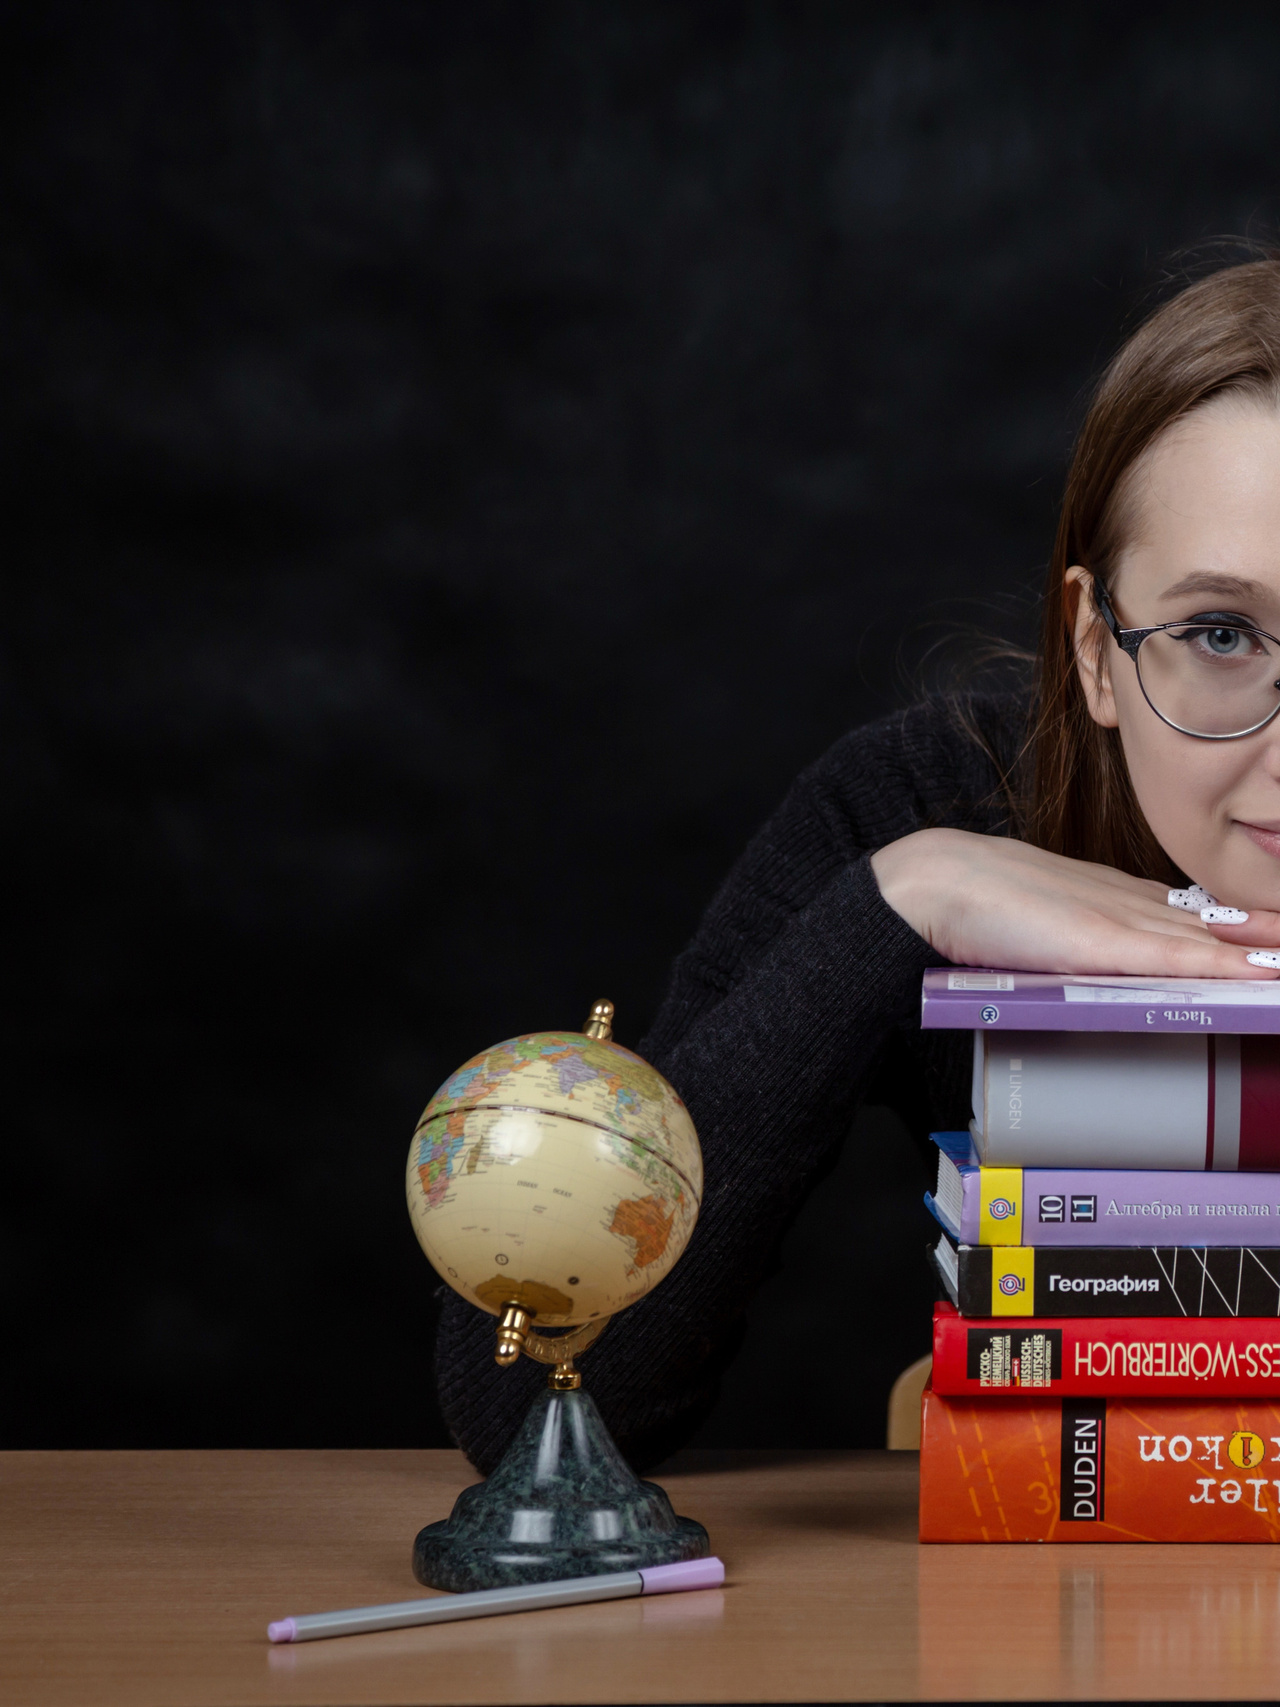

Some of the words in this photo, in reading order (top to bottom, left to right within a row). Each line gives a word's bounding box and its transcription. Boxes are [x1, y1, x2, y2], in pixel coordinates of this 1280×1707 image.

[1145, 1010, 1155, 1024] 3
[1163, 1010, 1212, 1026] Часть
[1009, 1074, 1022, 1130] LINGEN
[1041, 1195, 1063, 1222] 10
[1072, 1196, 1094, 1222] 11
[1105, 1199, 1182, 1220] Алгебра
[1188, 1202, 1200, 1216] и
[1205, 1202, 1271, 1217] начала
[1049, 1275, 1159, 1296] География
[989, 1336, 1003, 1387] НЕМЕЦКИЙ
[1021, 1337, 1031, 1387] RUSSISCH-
[1033, 1334, 1044, 1387] DEUTSCHES
[1073, 1418, 1097, 1518] DUDEN
